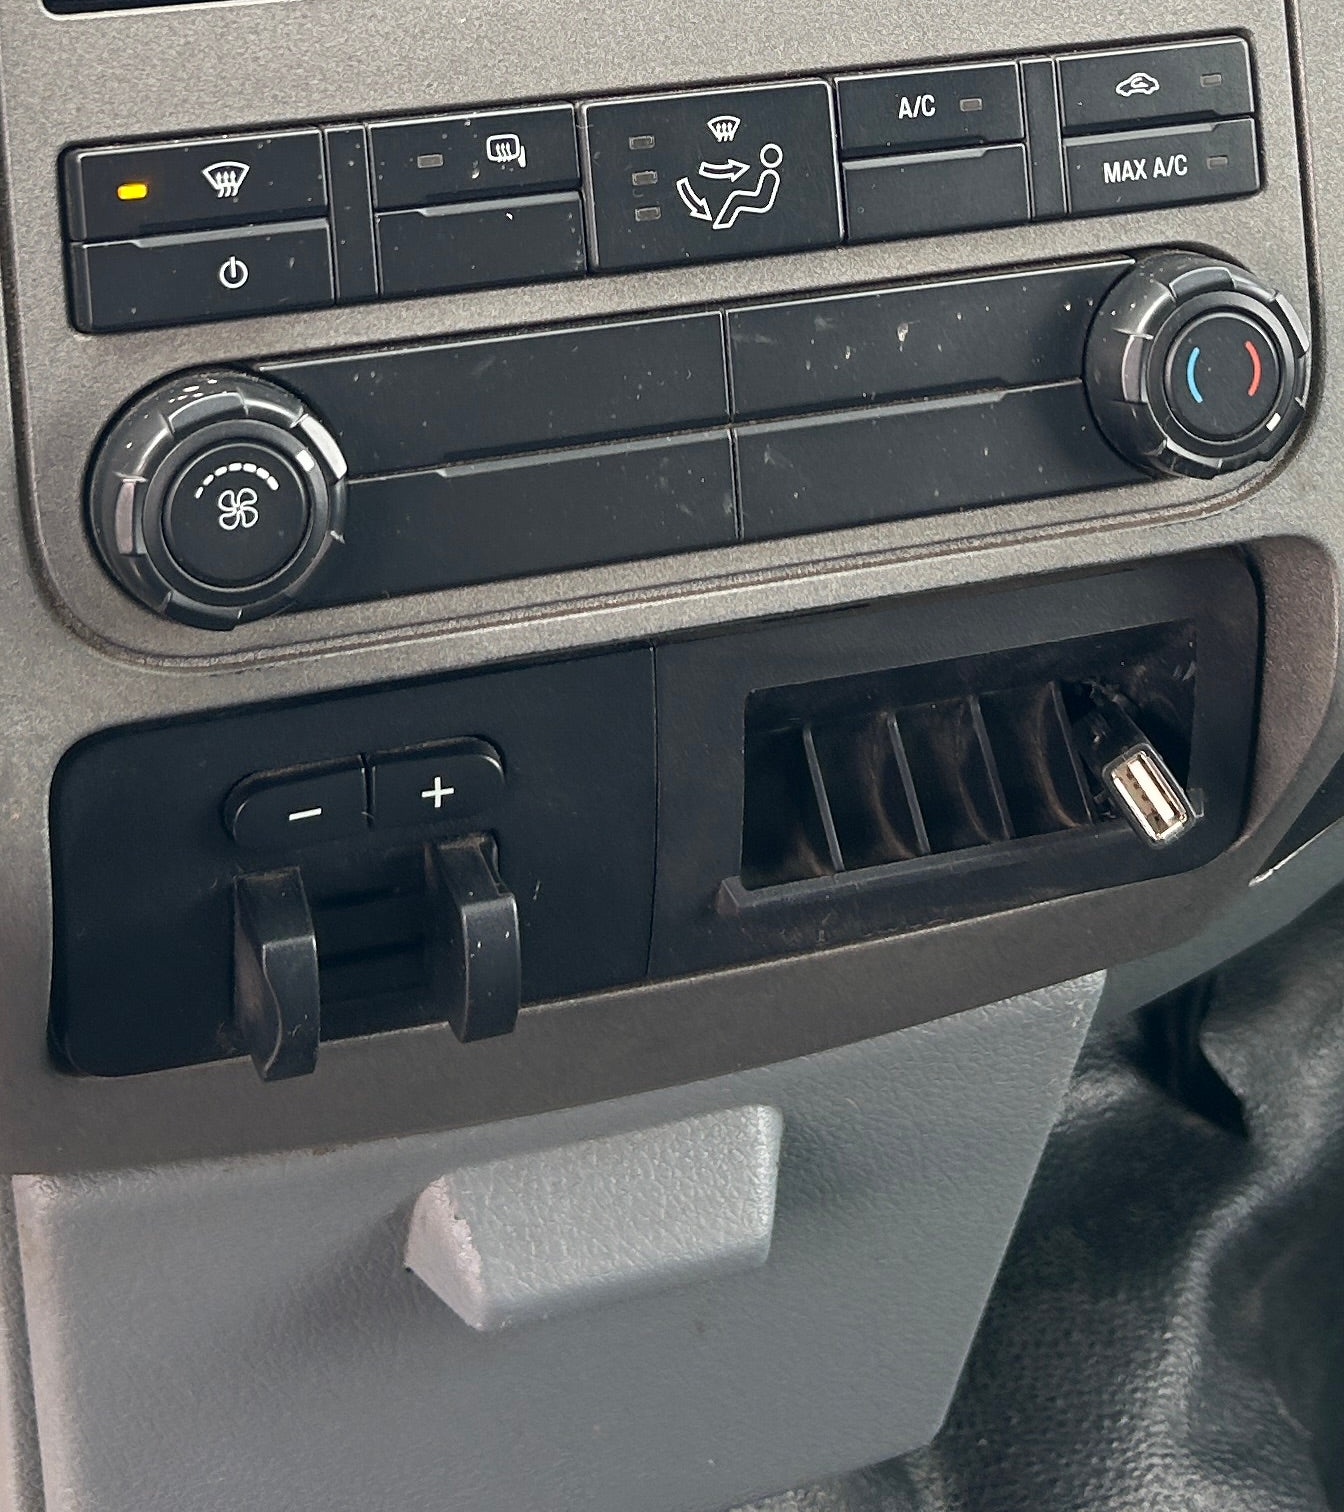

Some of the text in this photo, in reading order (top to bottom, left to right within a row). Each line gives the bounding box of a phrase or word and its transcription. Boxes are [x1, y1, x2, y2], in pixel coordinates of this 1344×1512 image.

[897, 93, 937, 120] A/C
[1103, 154, 1188, 184] MAX A/C
